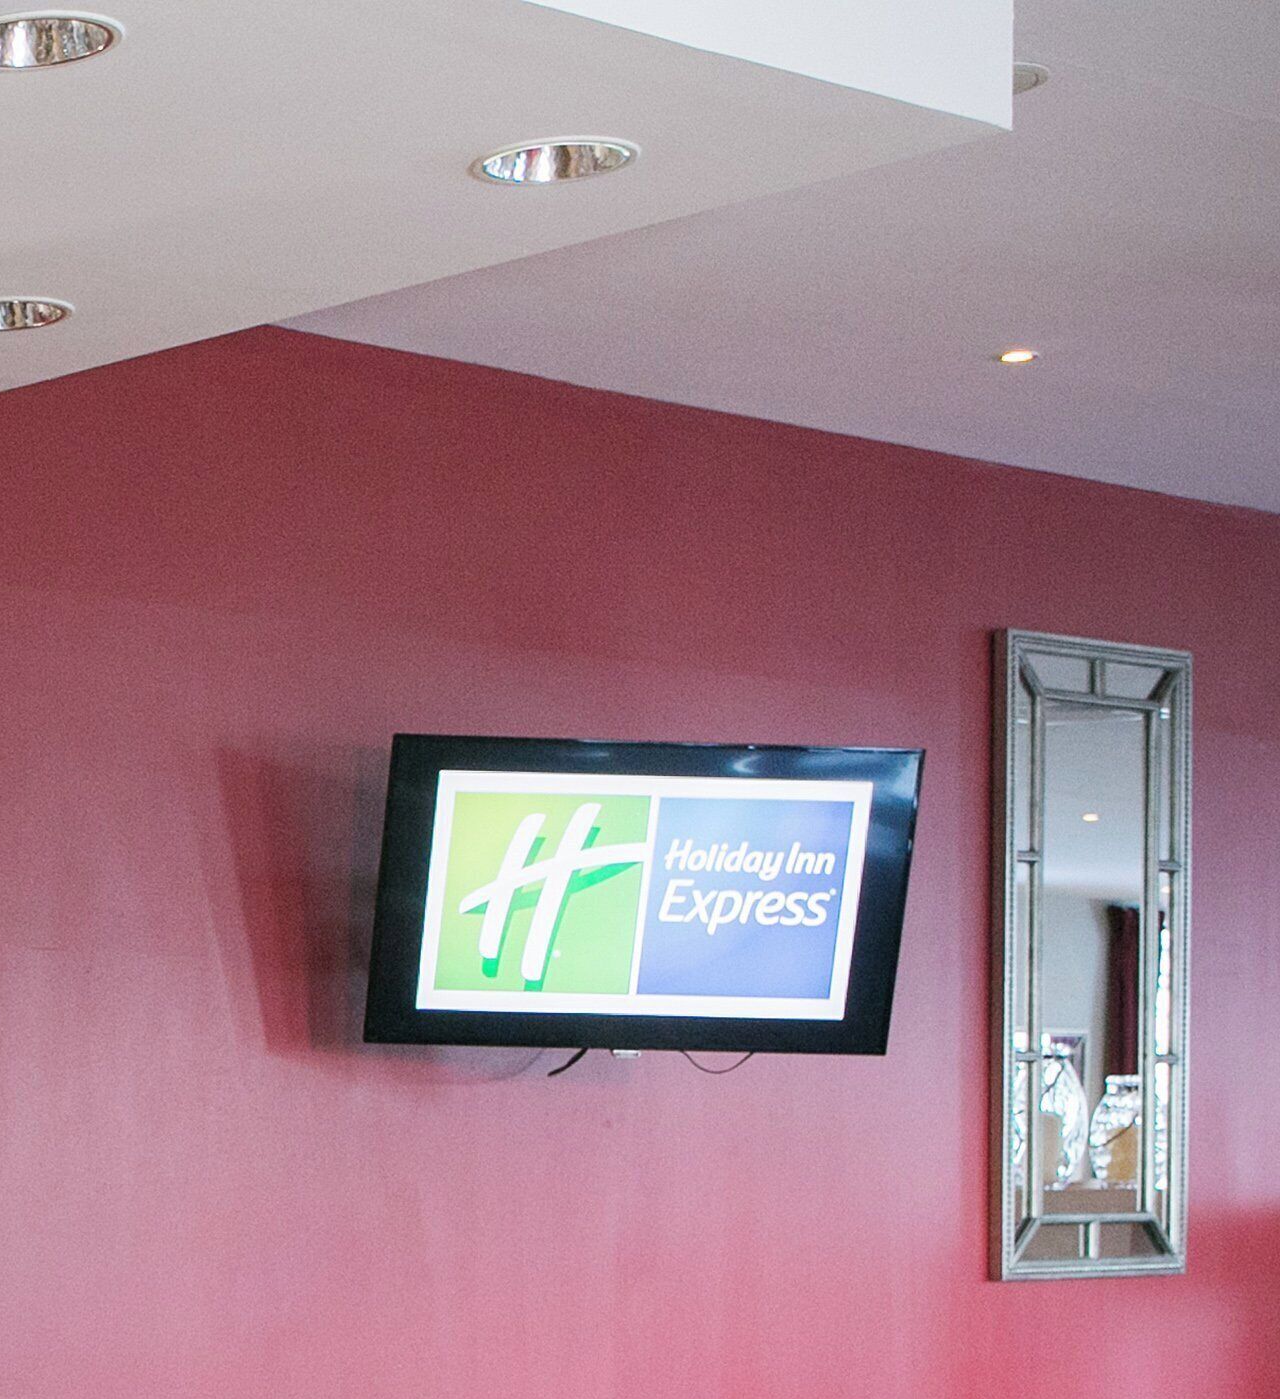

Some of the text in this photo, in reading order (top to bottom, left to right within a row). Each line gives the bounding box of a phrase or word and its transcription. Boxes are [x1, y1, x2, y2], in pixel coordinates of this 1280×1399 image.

[664, 838, 836, 881] Holiday Inn
[658, 879, 832, 935] Express
